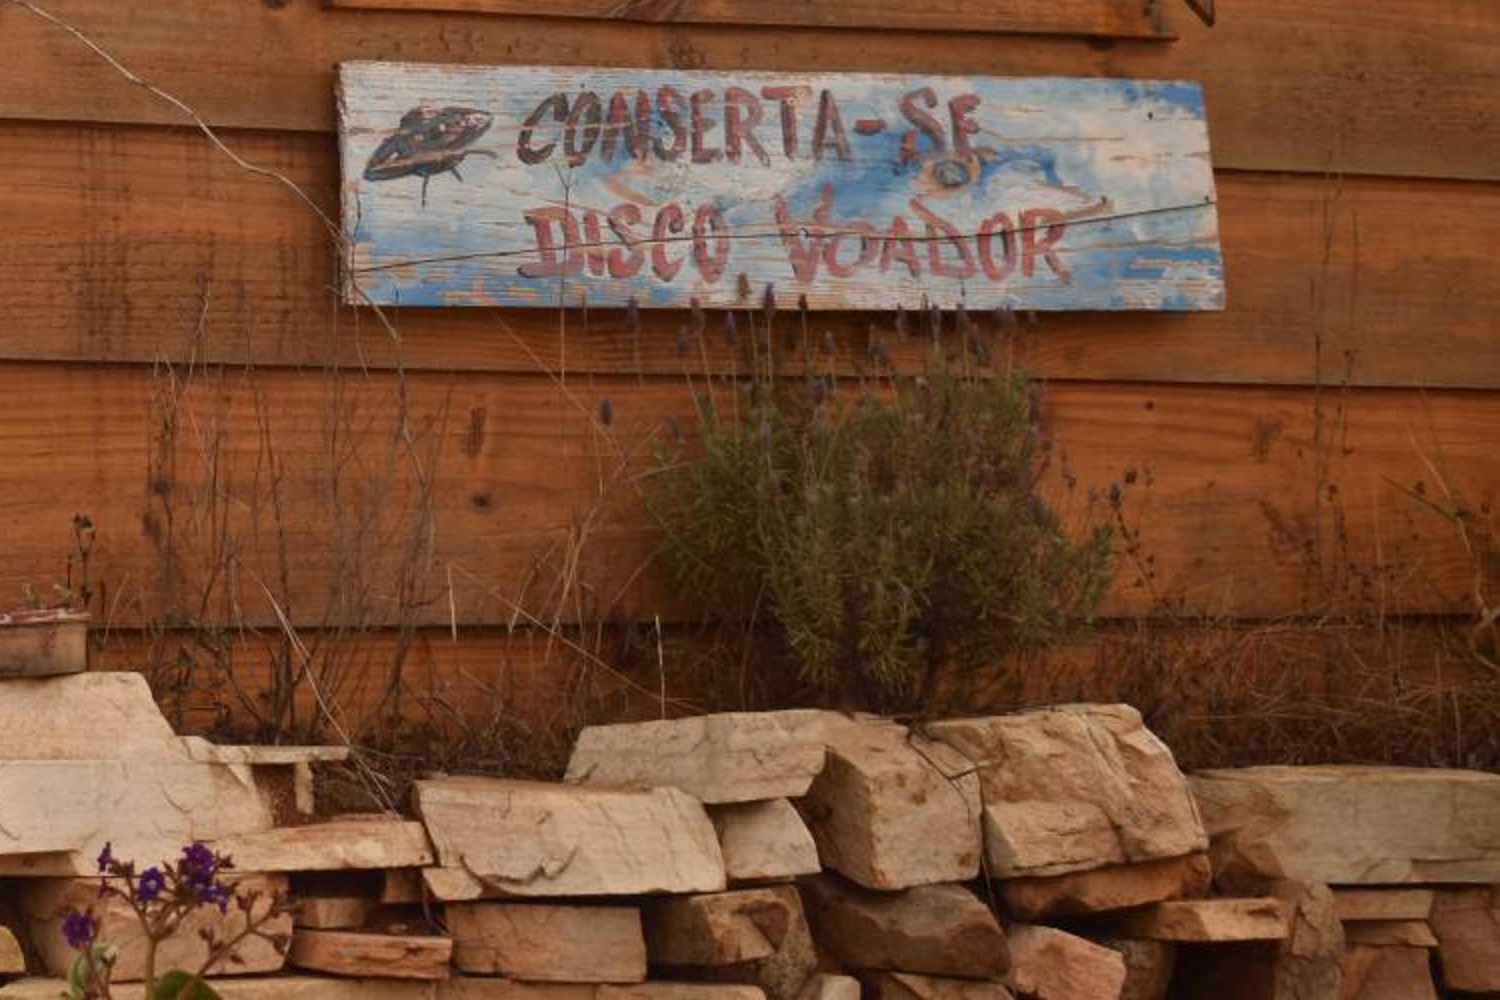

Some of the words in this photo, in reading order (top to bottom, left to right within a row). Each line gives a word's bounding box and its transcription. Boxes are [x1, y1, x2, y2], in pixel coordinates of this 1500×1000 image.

[517, 85, 984, 168] CONSERTA-SE
[517, 203, 731, 282] DISCO
[773, 185, 1073, 283] VOADOR
